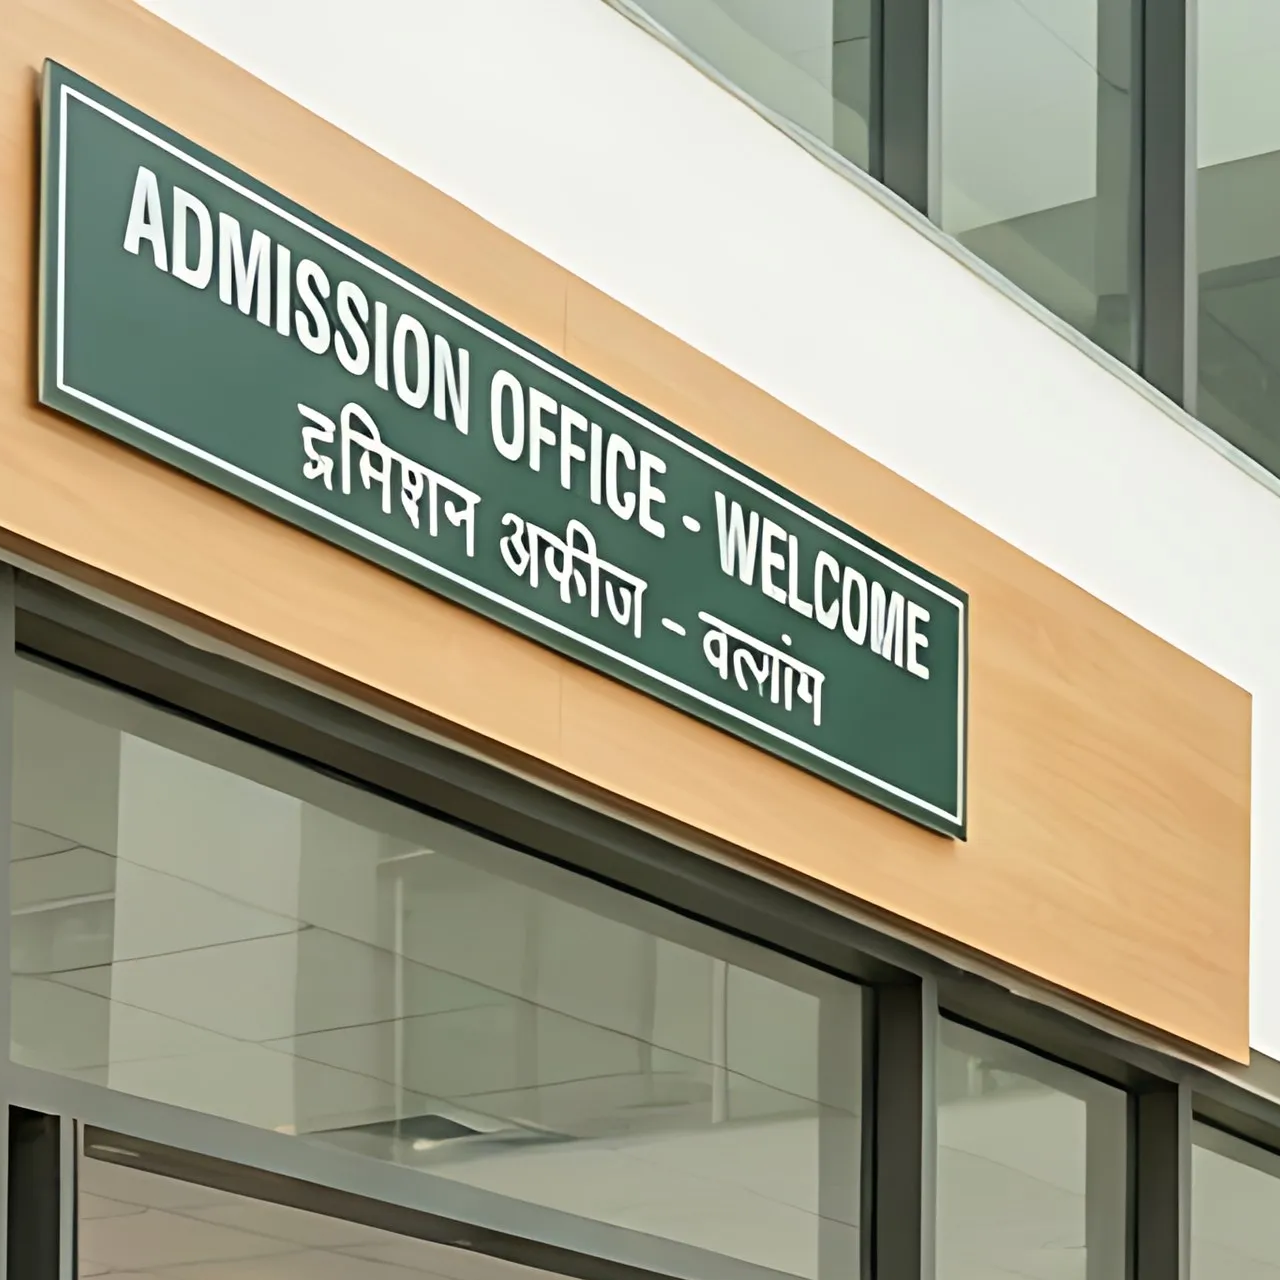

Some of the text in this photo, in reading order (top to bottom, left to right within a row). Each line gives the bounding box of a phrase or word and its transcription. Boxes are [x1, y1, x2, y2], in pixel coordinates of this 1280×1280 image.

[123, 165, 470, 436] ADMISSION
[490, 369, 667, 539] OFFICE
[714, 490, 931, 680] WELCOME
